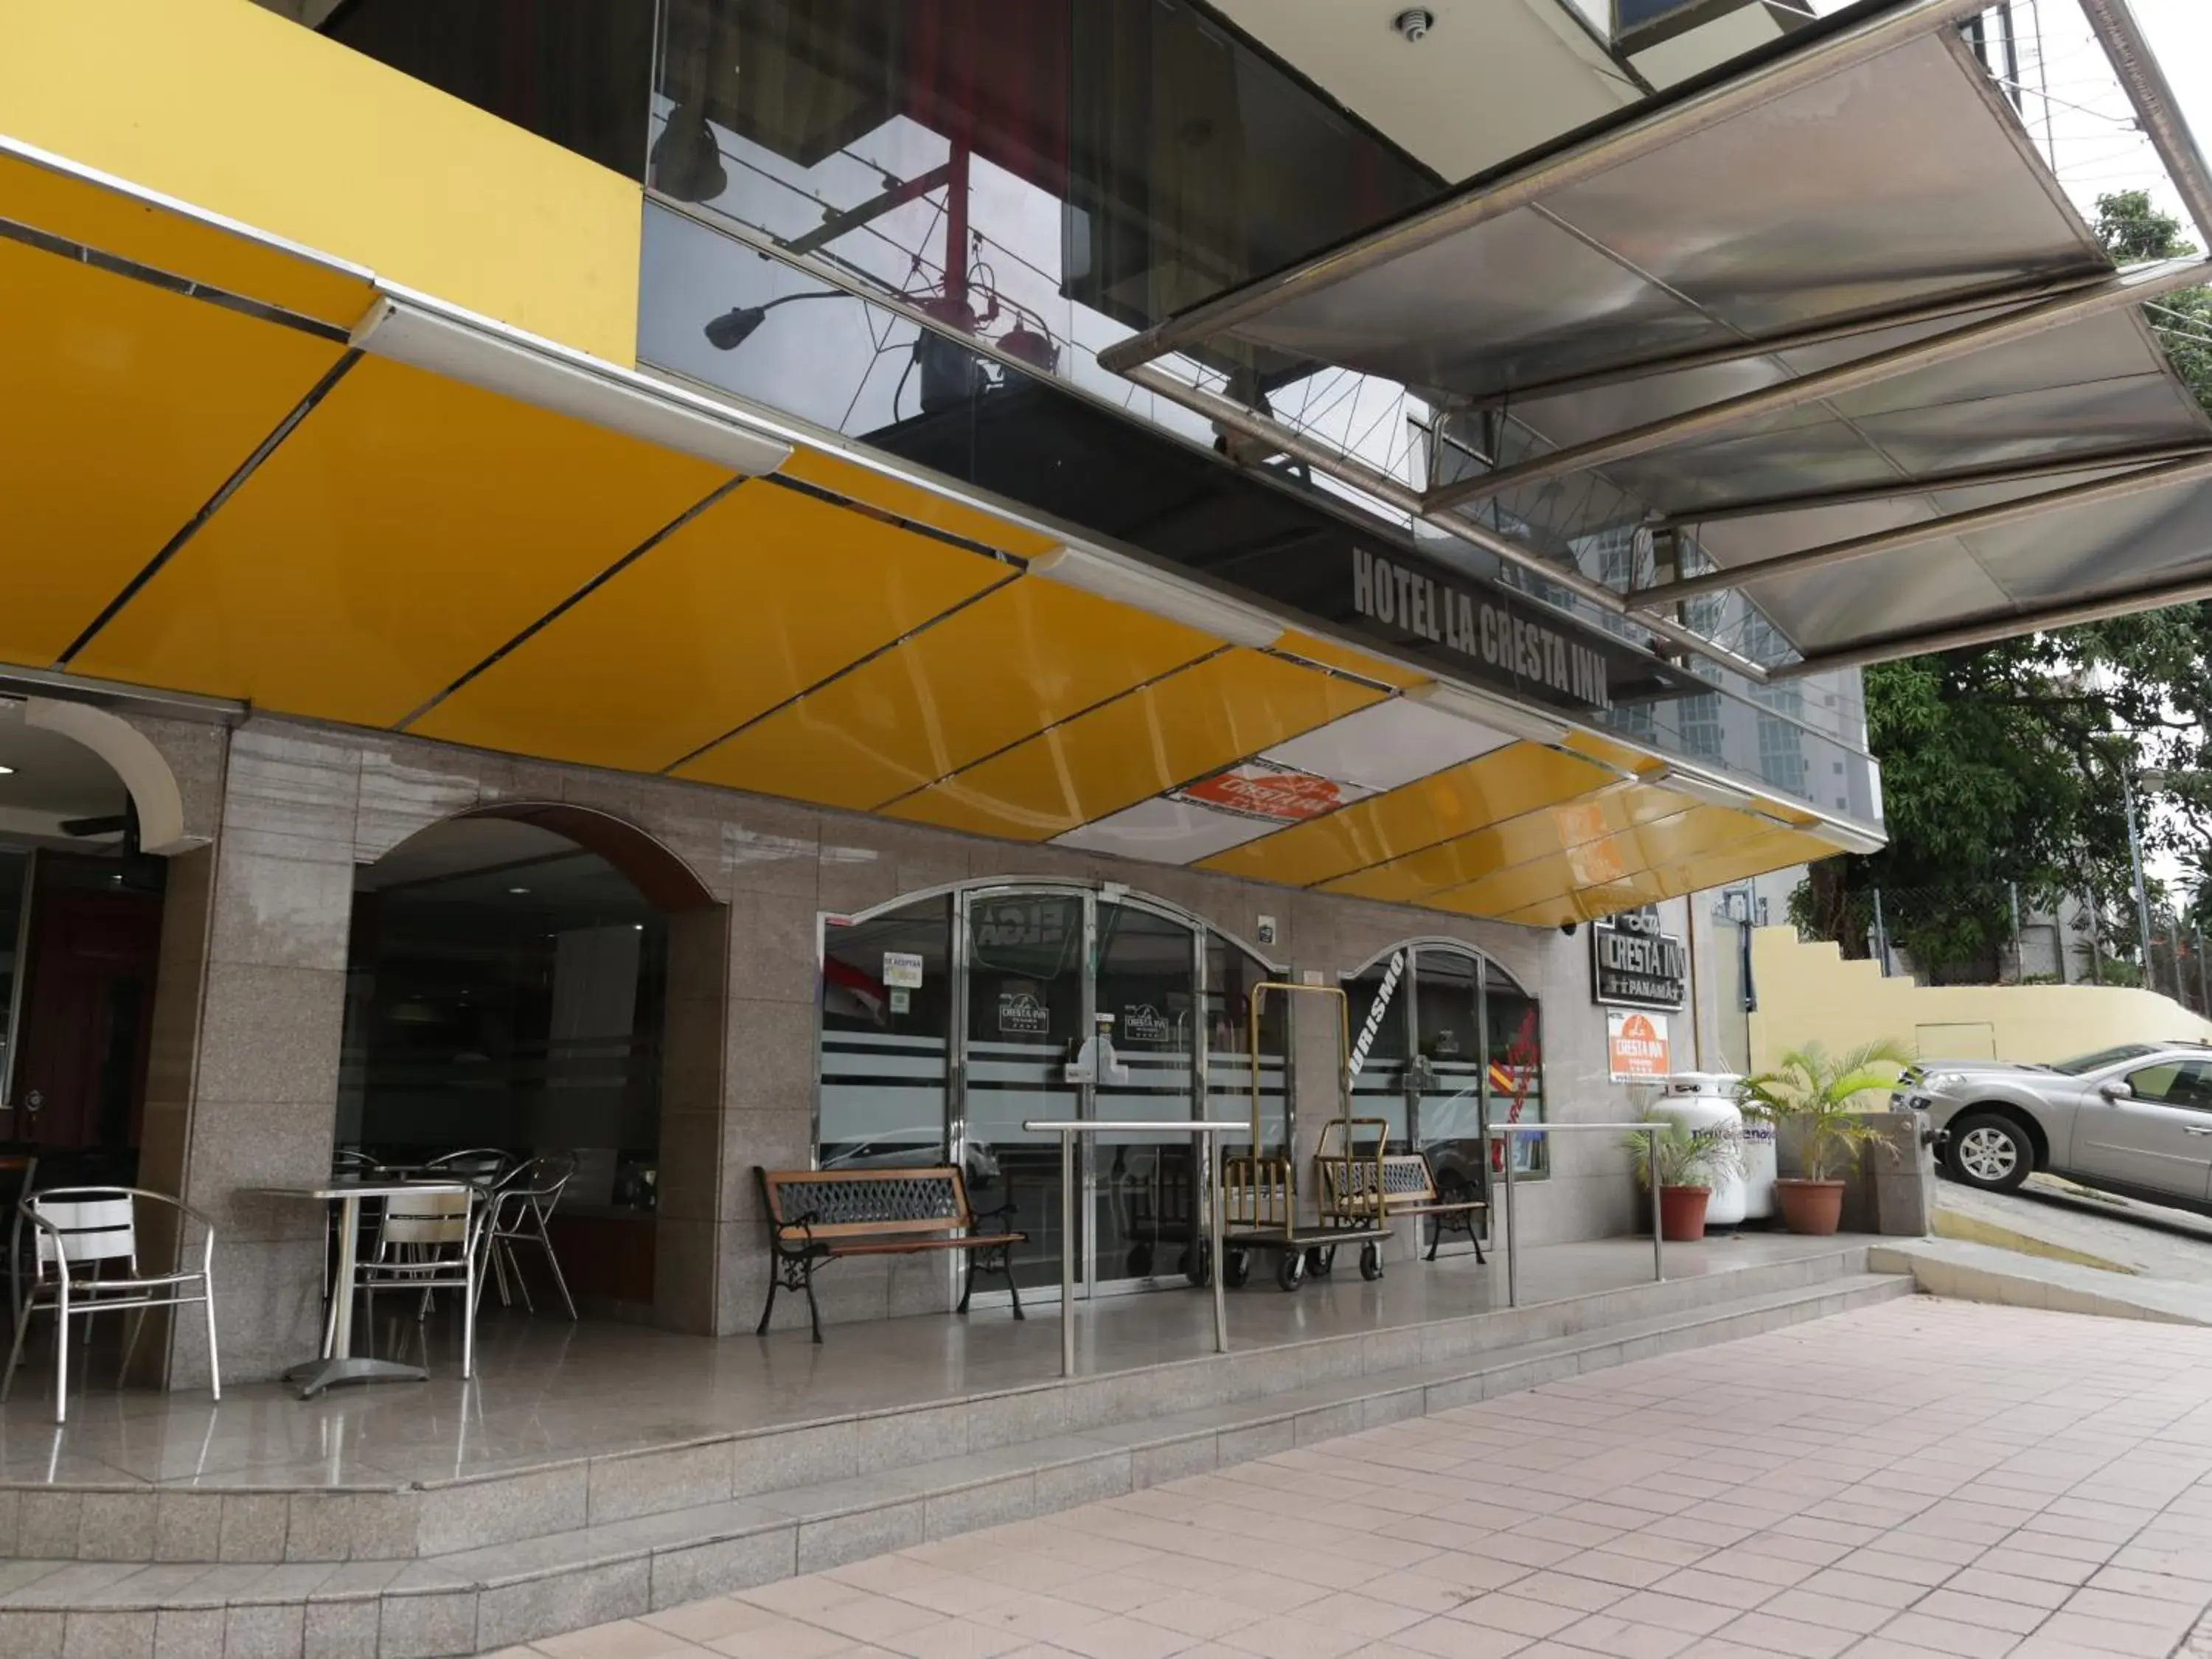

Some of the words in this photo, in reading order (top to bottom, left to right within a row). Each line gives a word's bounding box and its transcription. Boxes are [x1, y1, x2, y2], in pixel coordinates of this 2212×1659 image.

[1353, 547, 1441, 642] HOTEL
[1444, 586, 1476, 656] LA
[1480, 603, 1570, 693] CRESTA
[1349, 951, 1405, 1093] URISMO
[1608, 933, 1662, 975] CRESTA
[1664, 943, 1687, 979] INN
